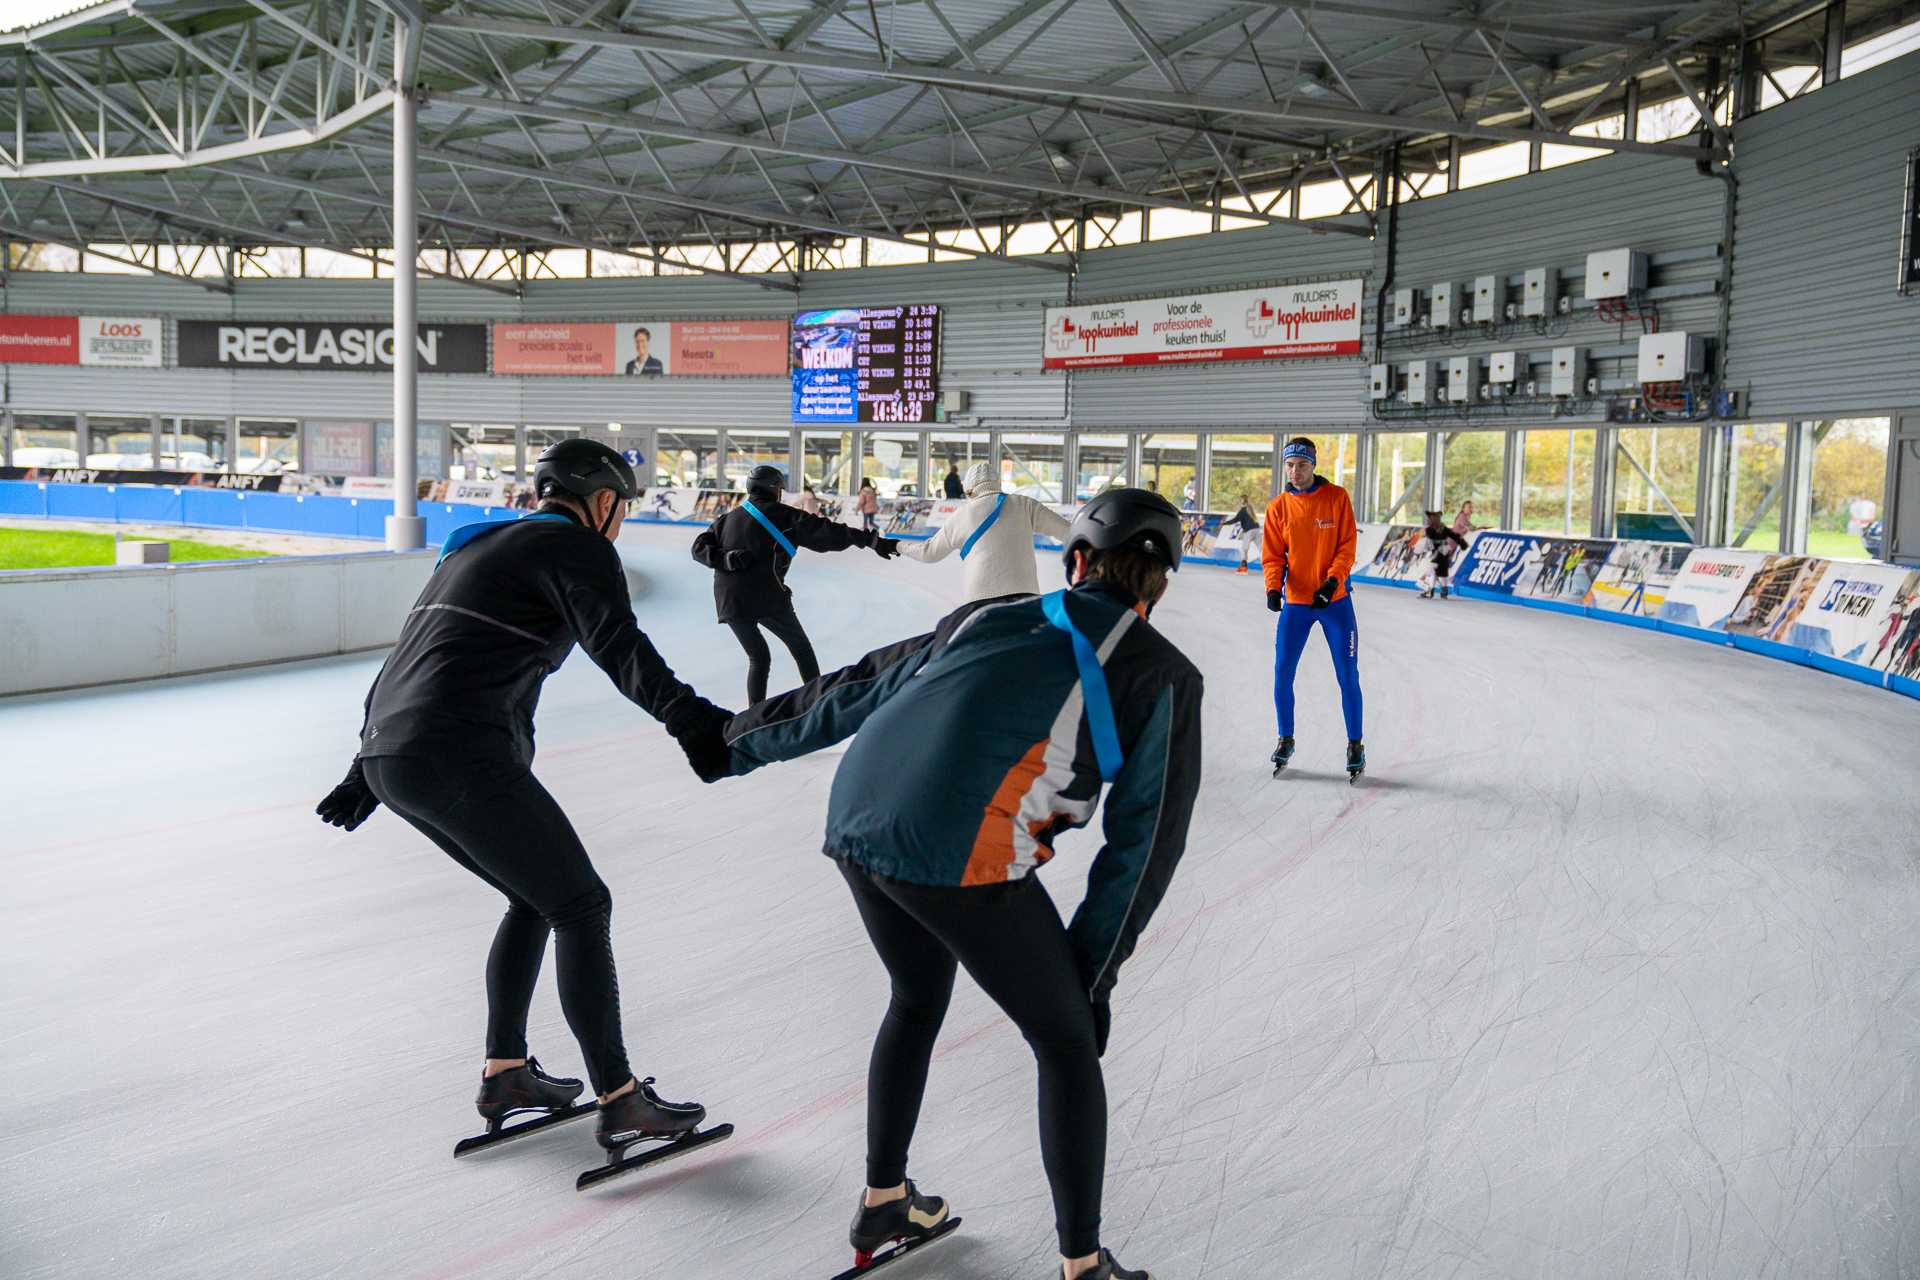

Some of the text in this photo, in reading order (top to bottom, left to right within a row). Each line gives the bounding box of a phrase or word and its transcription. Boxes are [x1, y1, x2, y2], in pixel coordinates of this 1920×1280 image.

[1167, 301, 1202, 315] Voor de
[872, 319, 896, 330] VIKING
[1153, 315, 1213, 334] professionele
[1278, 302, 1356, 334] kookwinkel
[1078, 320, 1139, 347] kookwinkel
[1165, 329, 1226, 346] keuken thuis!
[871, 343, 896, 354] VIKING
[802, 347, 853, 369] WELKOM
[871, 367, 895, 378] VIKING
[872, 401, 922, 422] 14:54:29
[628, 449, 639, 467] 3
[51, 469, 100, 484] ANFY
[216, 475, 264, 490] ANFY
